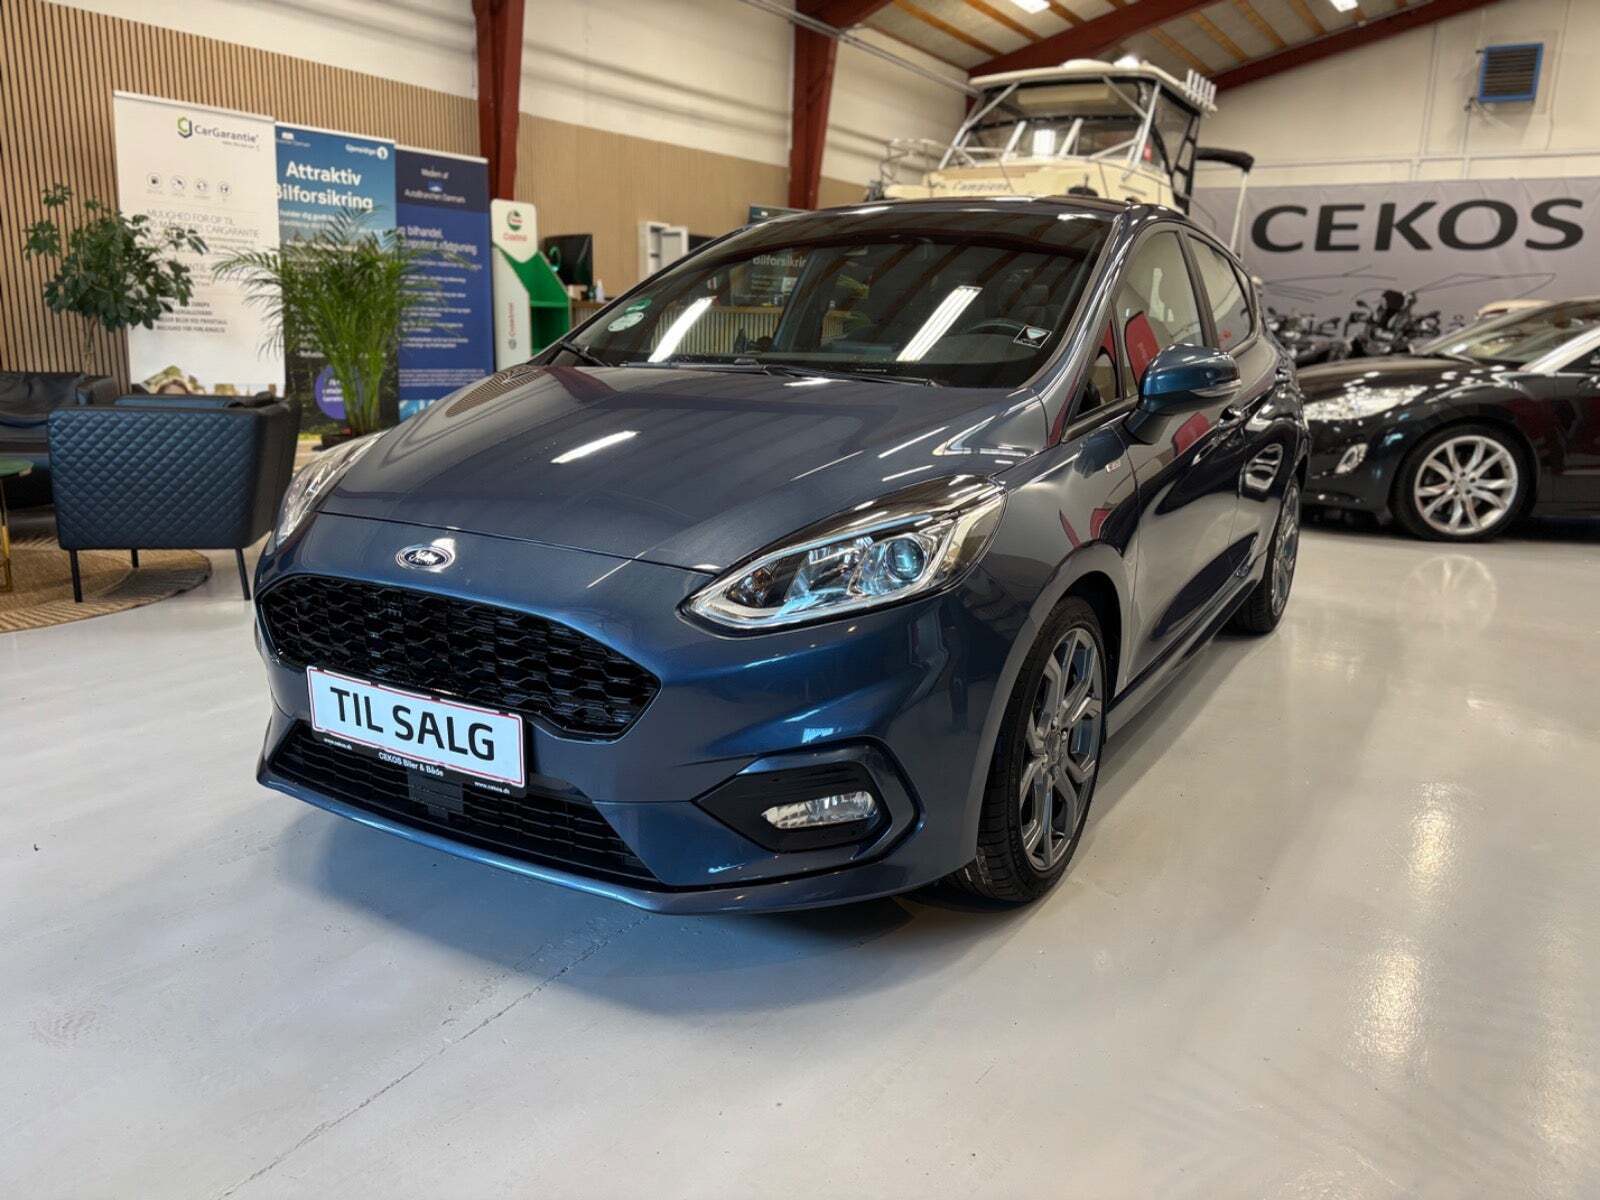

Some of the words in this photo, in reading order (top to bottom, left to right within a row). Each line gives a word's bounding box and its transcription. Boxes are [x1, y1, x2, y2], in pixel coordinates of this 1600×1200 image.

[286, 160, 361, 186] Attraktiv
[1251, 198, 1584, 253] CEKOS
[330, 687, 383, 734] TIL
[392, 704, 495, 762] SALG
[378, 751, 403, 766] CEKOS
[402, 759, 418, 771] Biler
